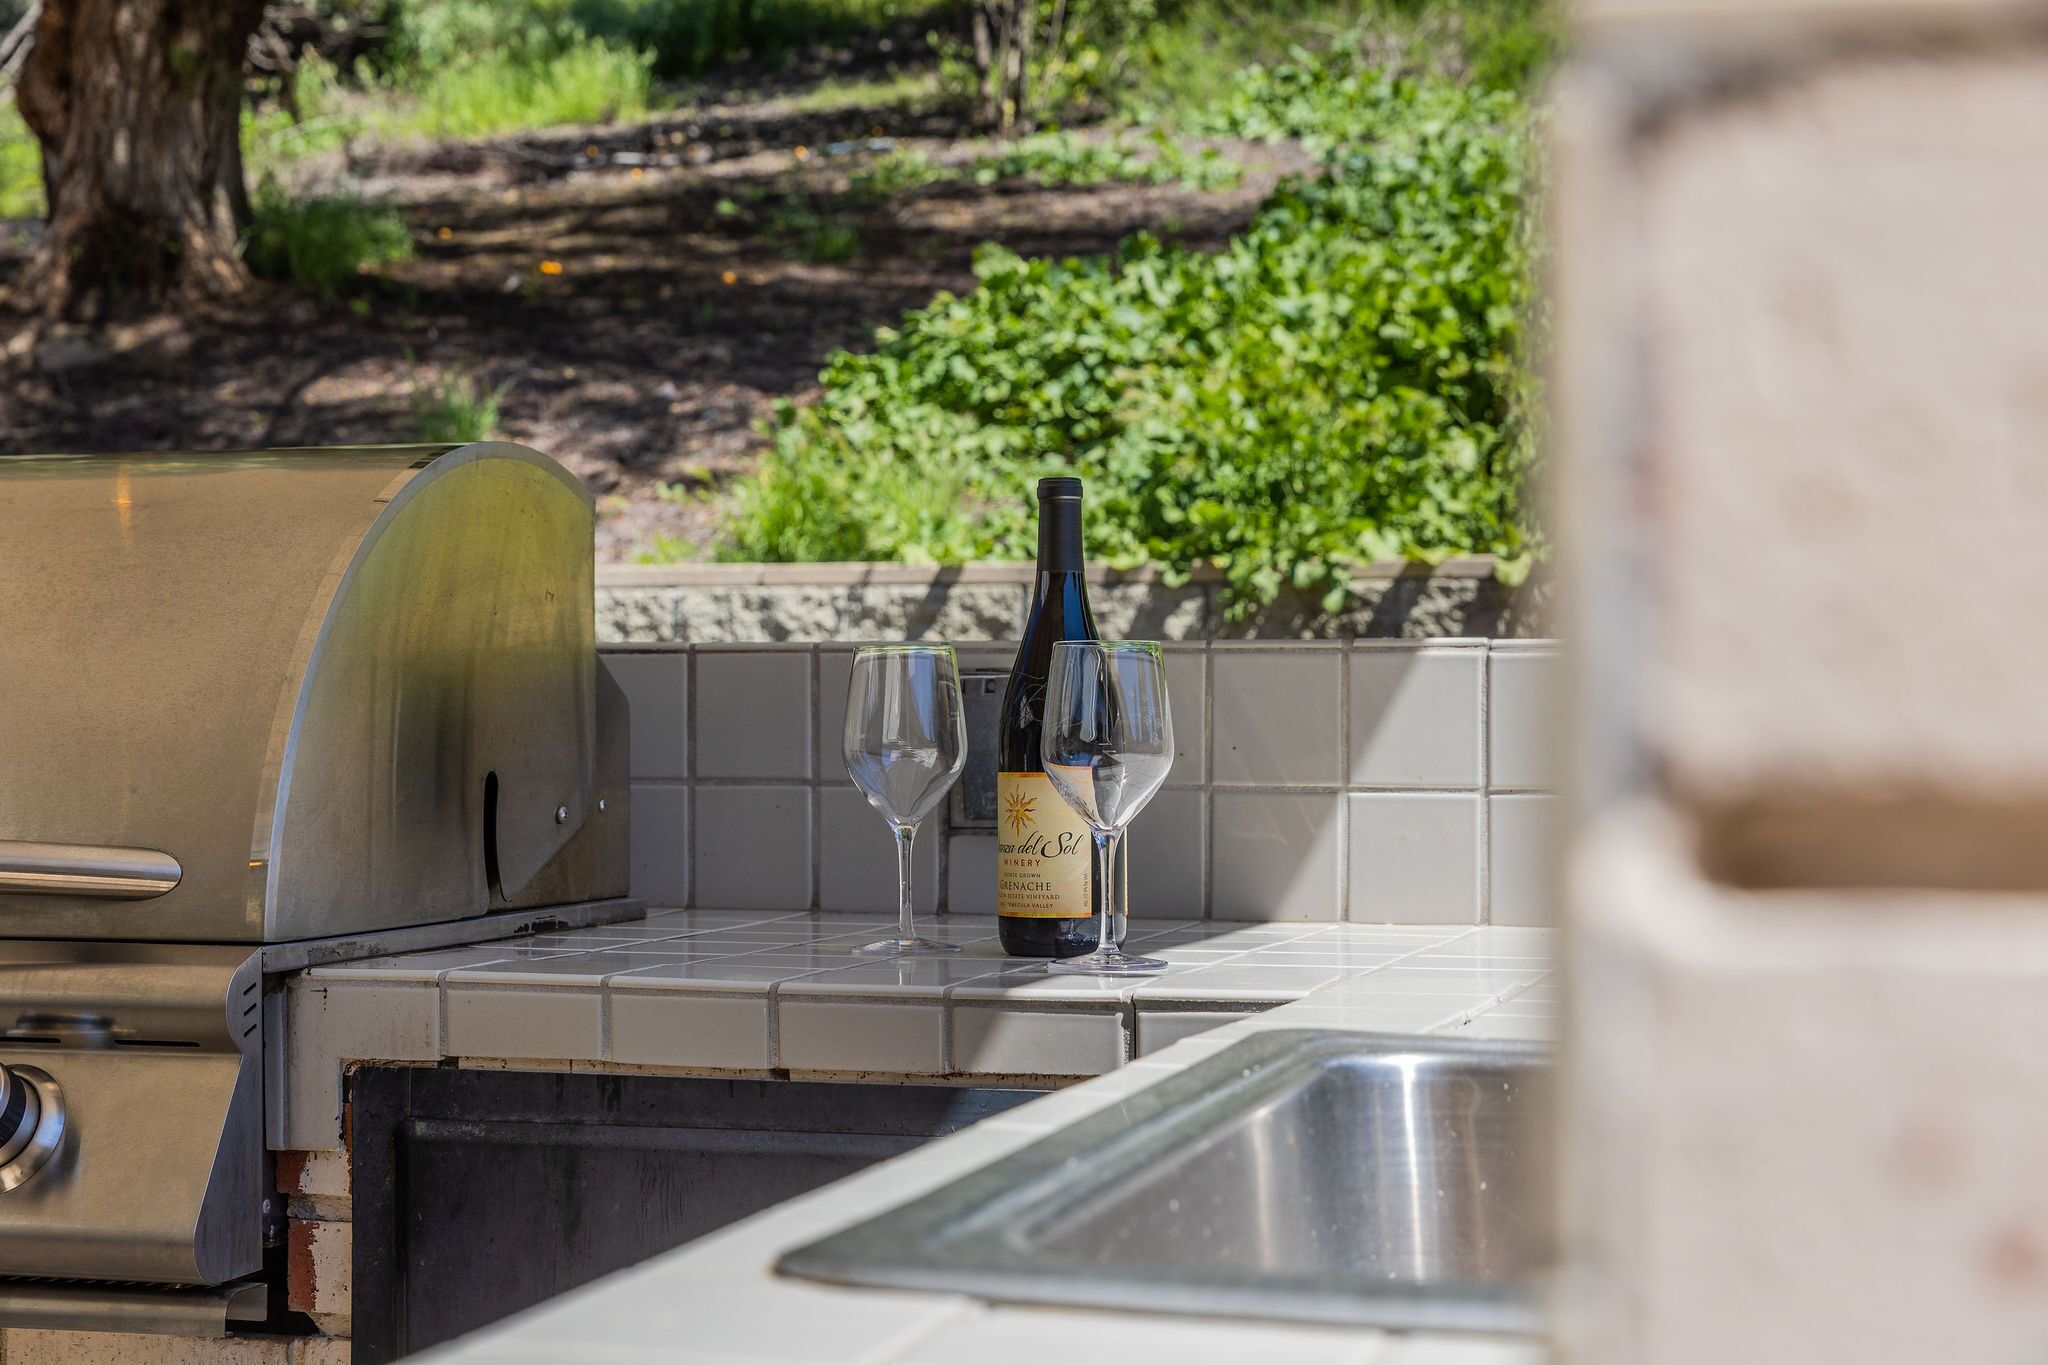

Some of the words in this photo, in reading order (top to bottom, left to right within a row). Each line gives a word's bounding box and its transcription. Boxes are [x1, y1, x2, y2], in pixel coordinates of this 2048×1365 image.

[1017, 831, 1043, 856] del
[1041, 832, 1084, 858] Sol
[1004, 859, 1041, 867] WINERY
[1000, 880, 1052, 892] GRENACHE
[1007, 901, 1031, 909] TEMECULA
